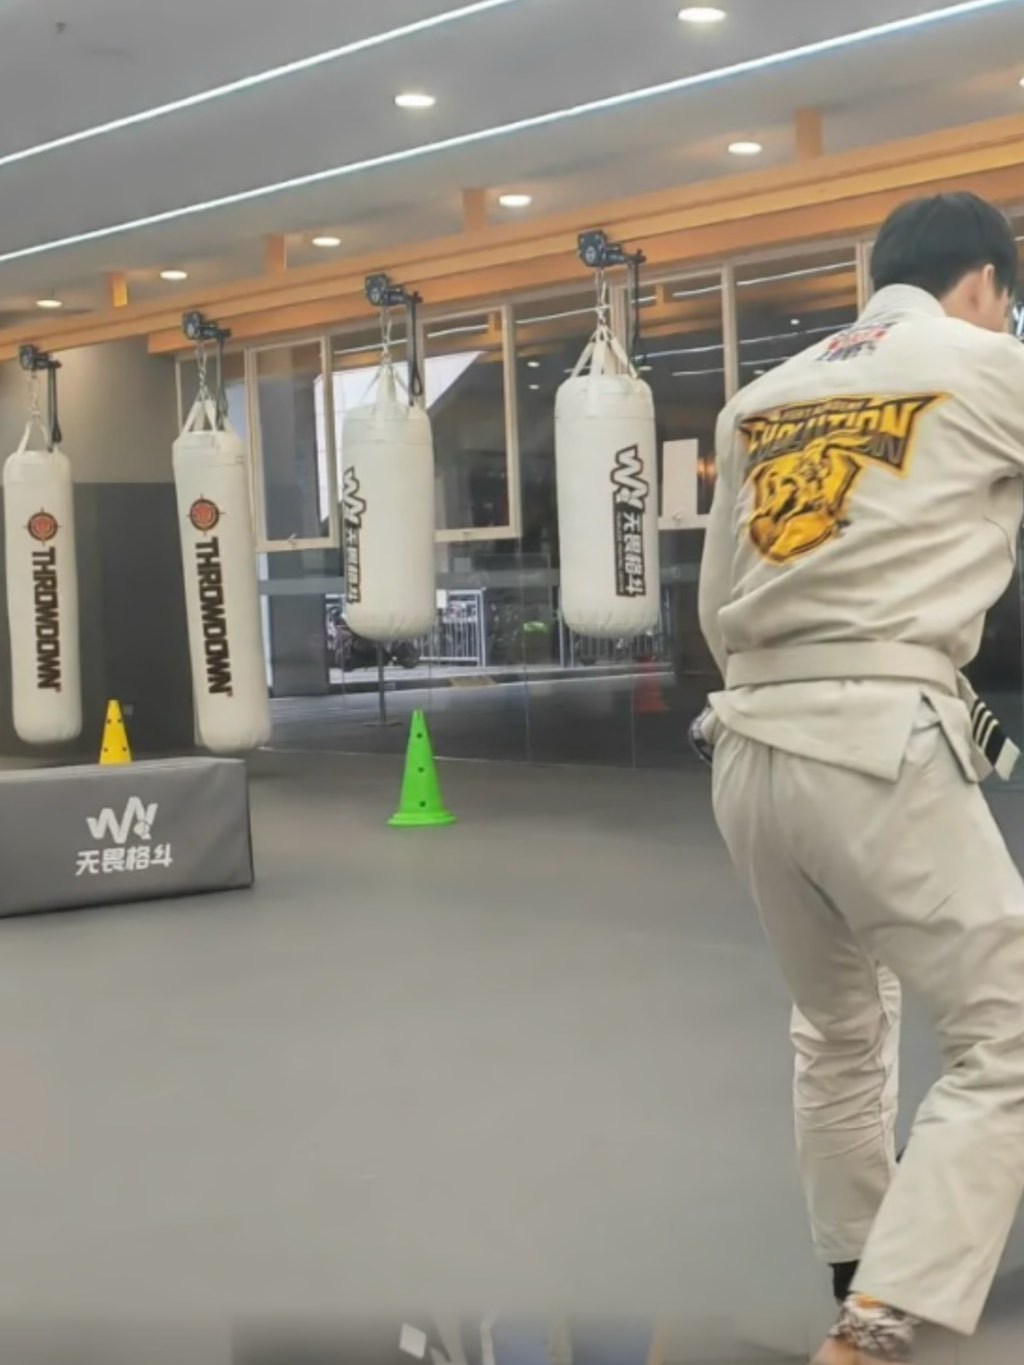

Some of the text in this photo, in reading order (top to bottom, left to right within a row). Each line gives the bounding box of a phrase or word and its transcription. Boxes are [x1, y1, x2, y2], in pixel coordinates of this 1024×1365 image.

[32, 546, 61, 689] THROWDOWN
[195, 536, 232, 693] THROWDOWN
[75, 843, 173, 876] 无畏格斗
